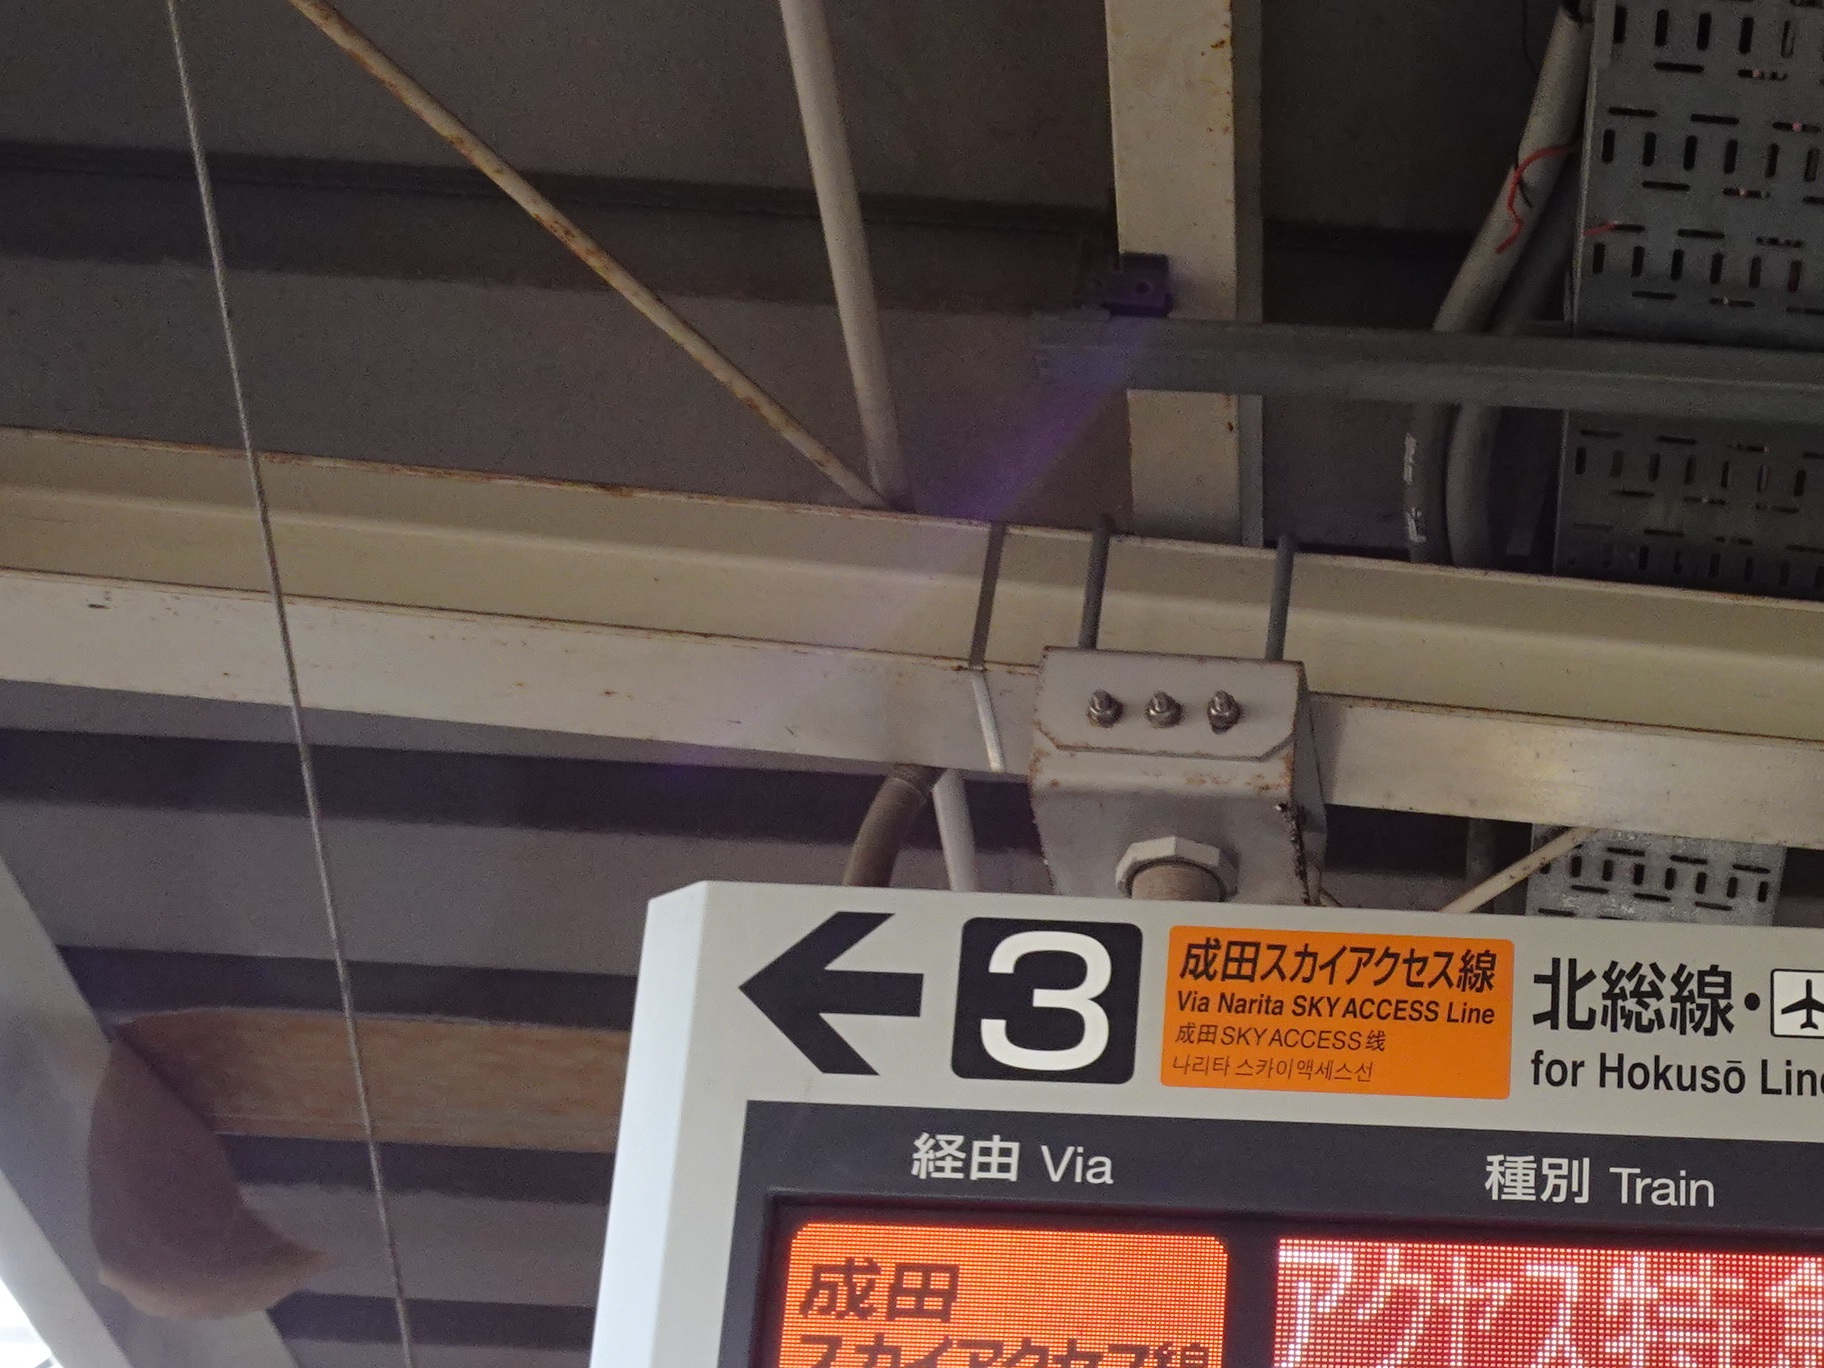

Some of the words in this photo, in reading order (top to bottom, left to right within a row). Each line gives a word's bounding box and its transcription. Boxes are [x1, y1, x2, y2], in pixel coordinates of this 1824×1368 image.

[1180, 937, 1497, 993] 成田スカイアクセス線
[980, 930, 1113, 1072] 3
[1177, 991, 1209, 1013] Via
[1218, 993, 1283, 1016] Narita
[1447, 1003, 1494, 1024] Line
[1173, 1055, 1231, 1077] 나리타
[1235, 1057, 1373, 1083] 스카이액세스선
[1530, 1050, 1584, 1088] for
[1599, 1053, 1745, 1096] Hokusō
[911, 1133, 1020, 1183] 経由
[1039, 1146, 1114, 1186] Via
[1485, 1153, 1590, 1206] 種別
[1610, 1168, 1715, 1208] Train
[801, 1258, 959, 1322] 成田
